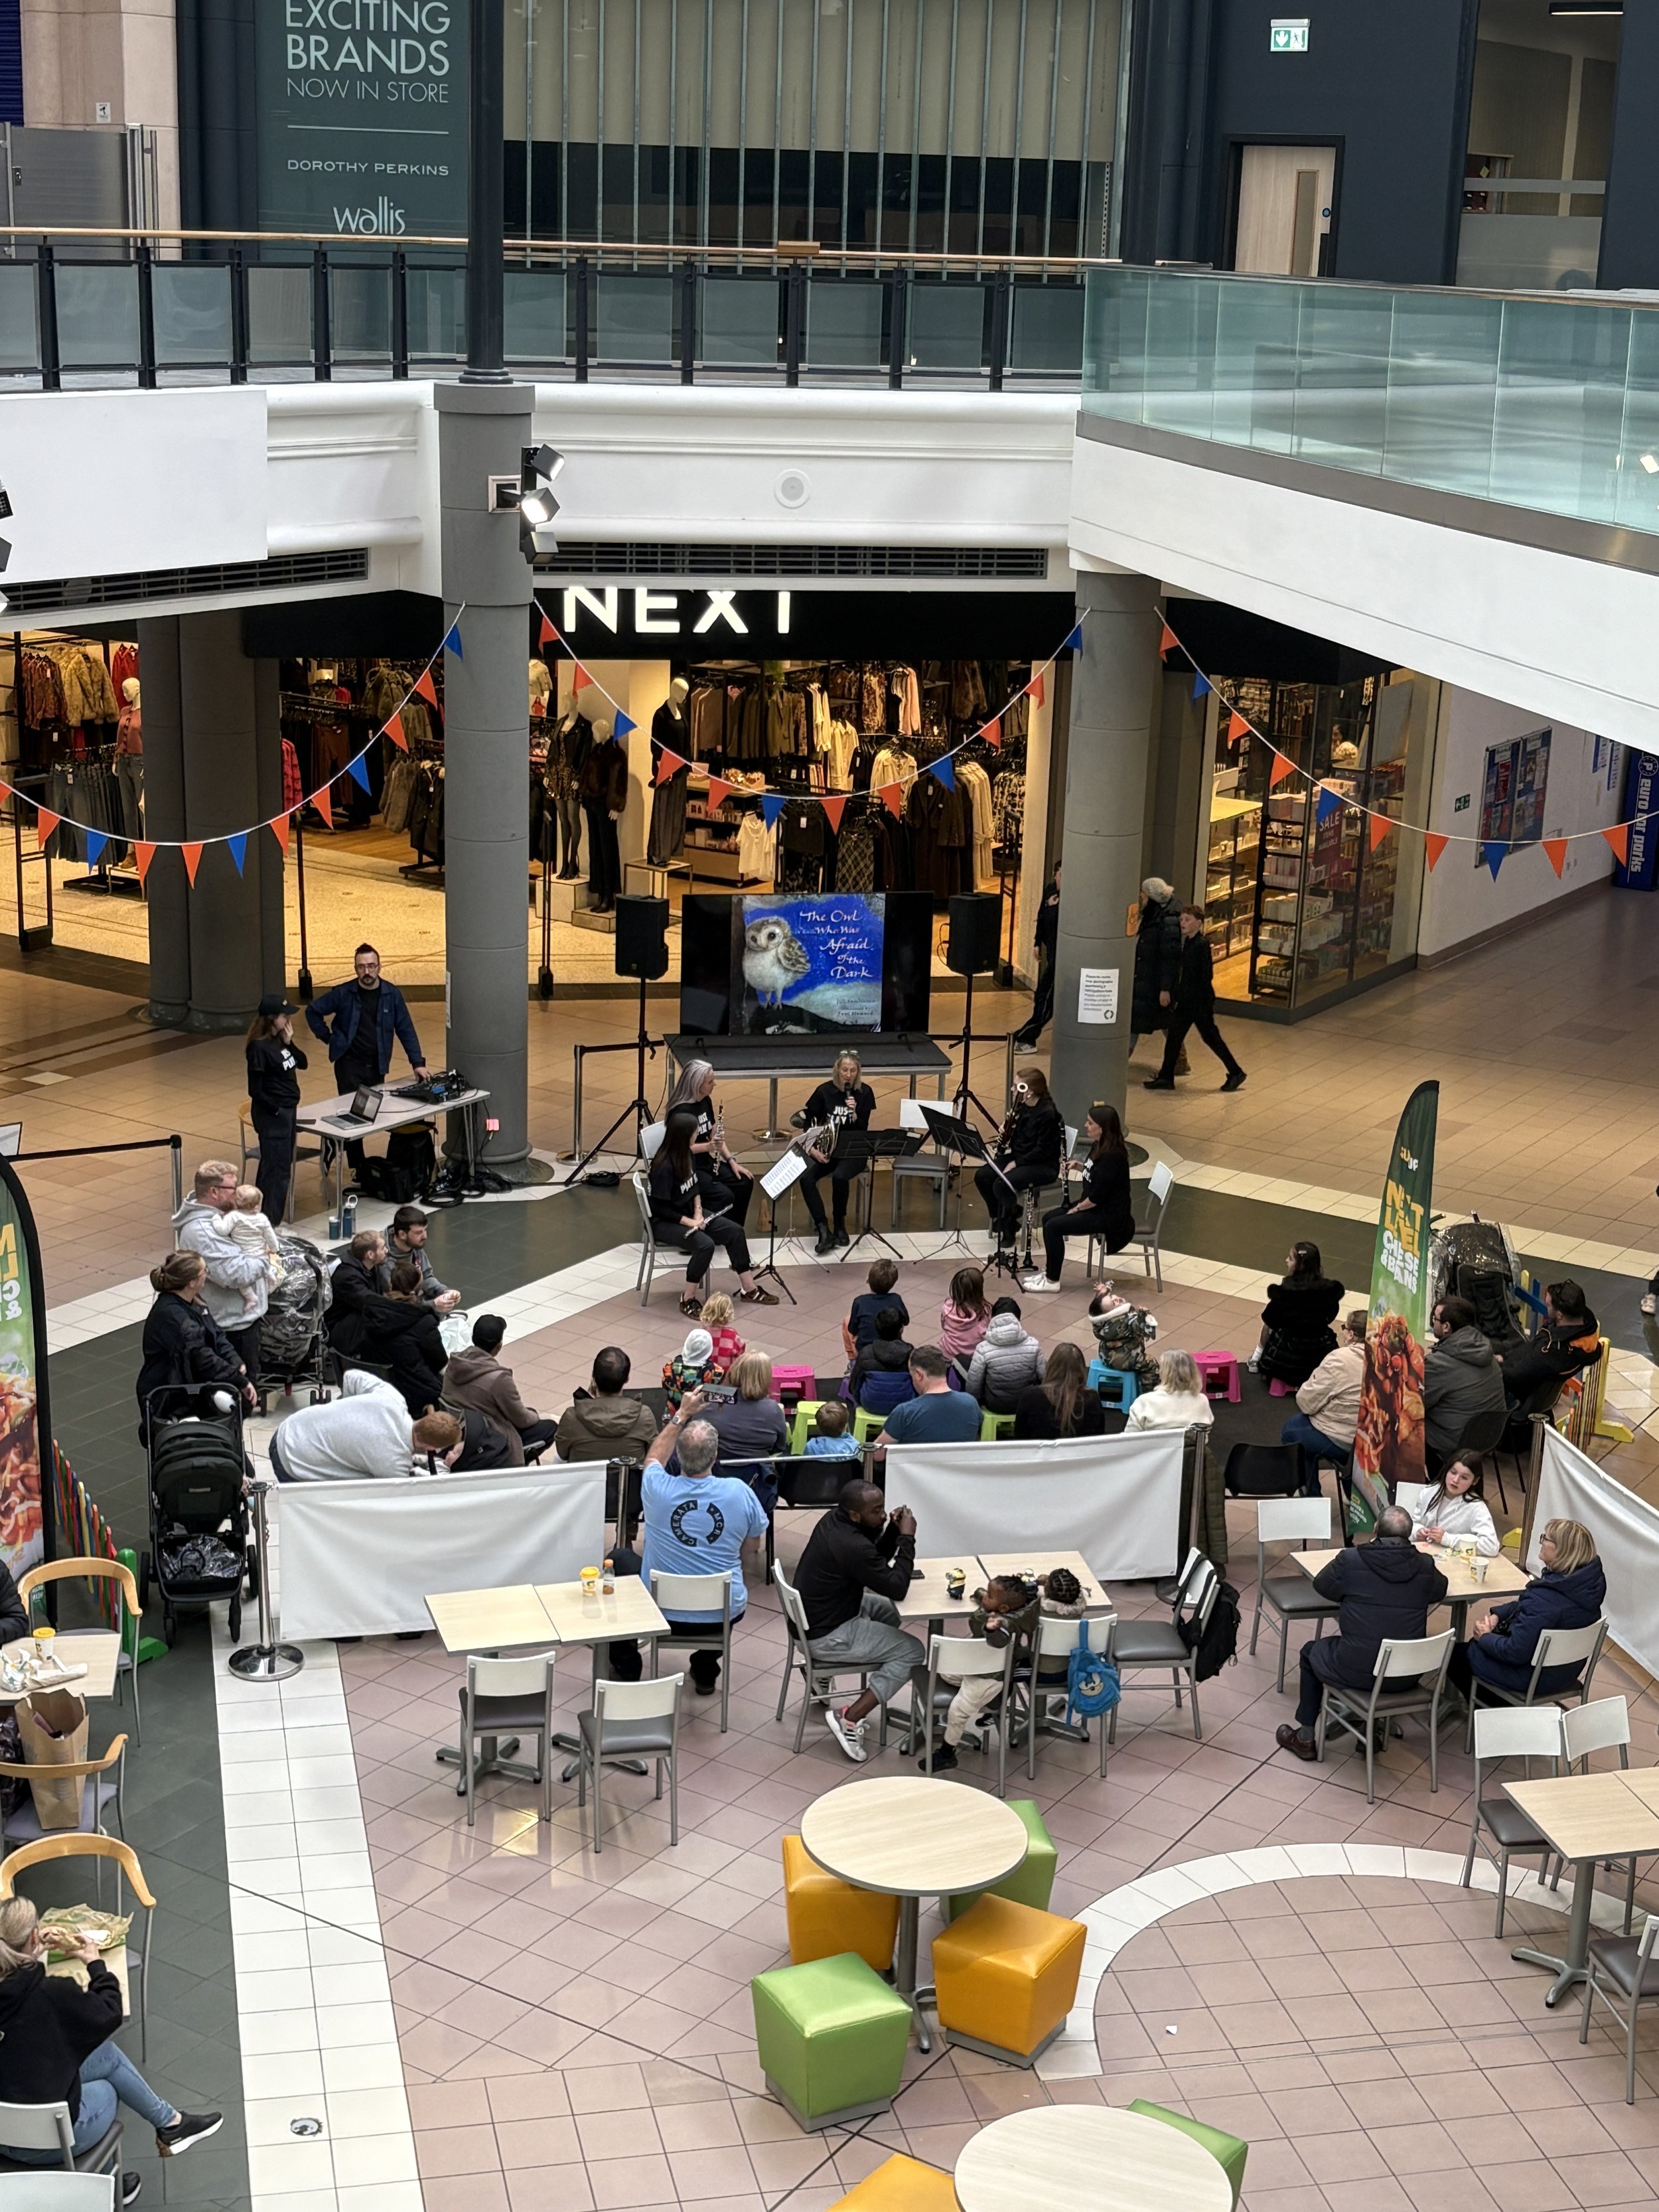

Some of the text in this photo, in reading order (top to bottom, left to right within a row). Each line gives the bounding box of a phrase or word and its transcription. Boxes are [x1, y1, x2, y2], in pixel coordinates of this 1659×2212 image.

[286, 0, 451, 34] EXCITING
[287, 35, 450, 76] BRANDS
[287, 78, 449, 104] NOW IN STORE
[287, 159, 449, 176] DOROTHY PERKINS
[1638, 778, 1652, 810] euro
[1319, 811, 1340, 832] SALE
[1630, 835, 1645, 873] parks
[800, 910, 863, 922] The Owl
[814, 924, 839, 934] Who
[820, 936, 873, 955] Afraid
[830, 966, 874, 979] Dark
[673, 1503, 723, 1545] CAMERATA MCR
